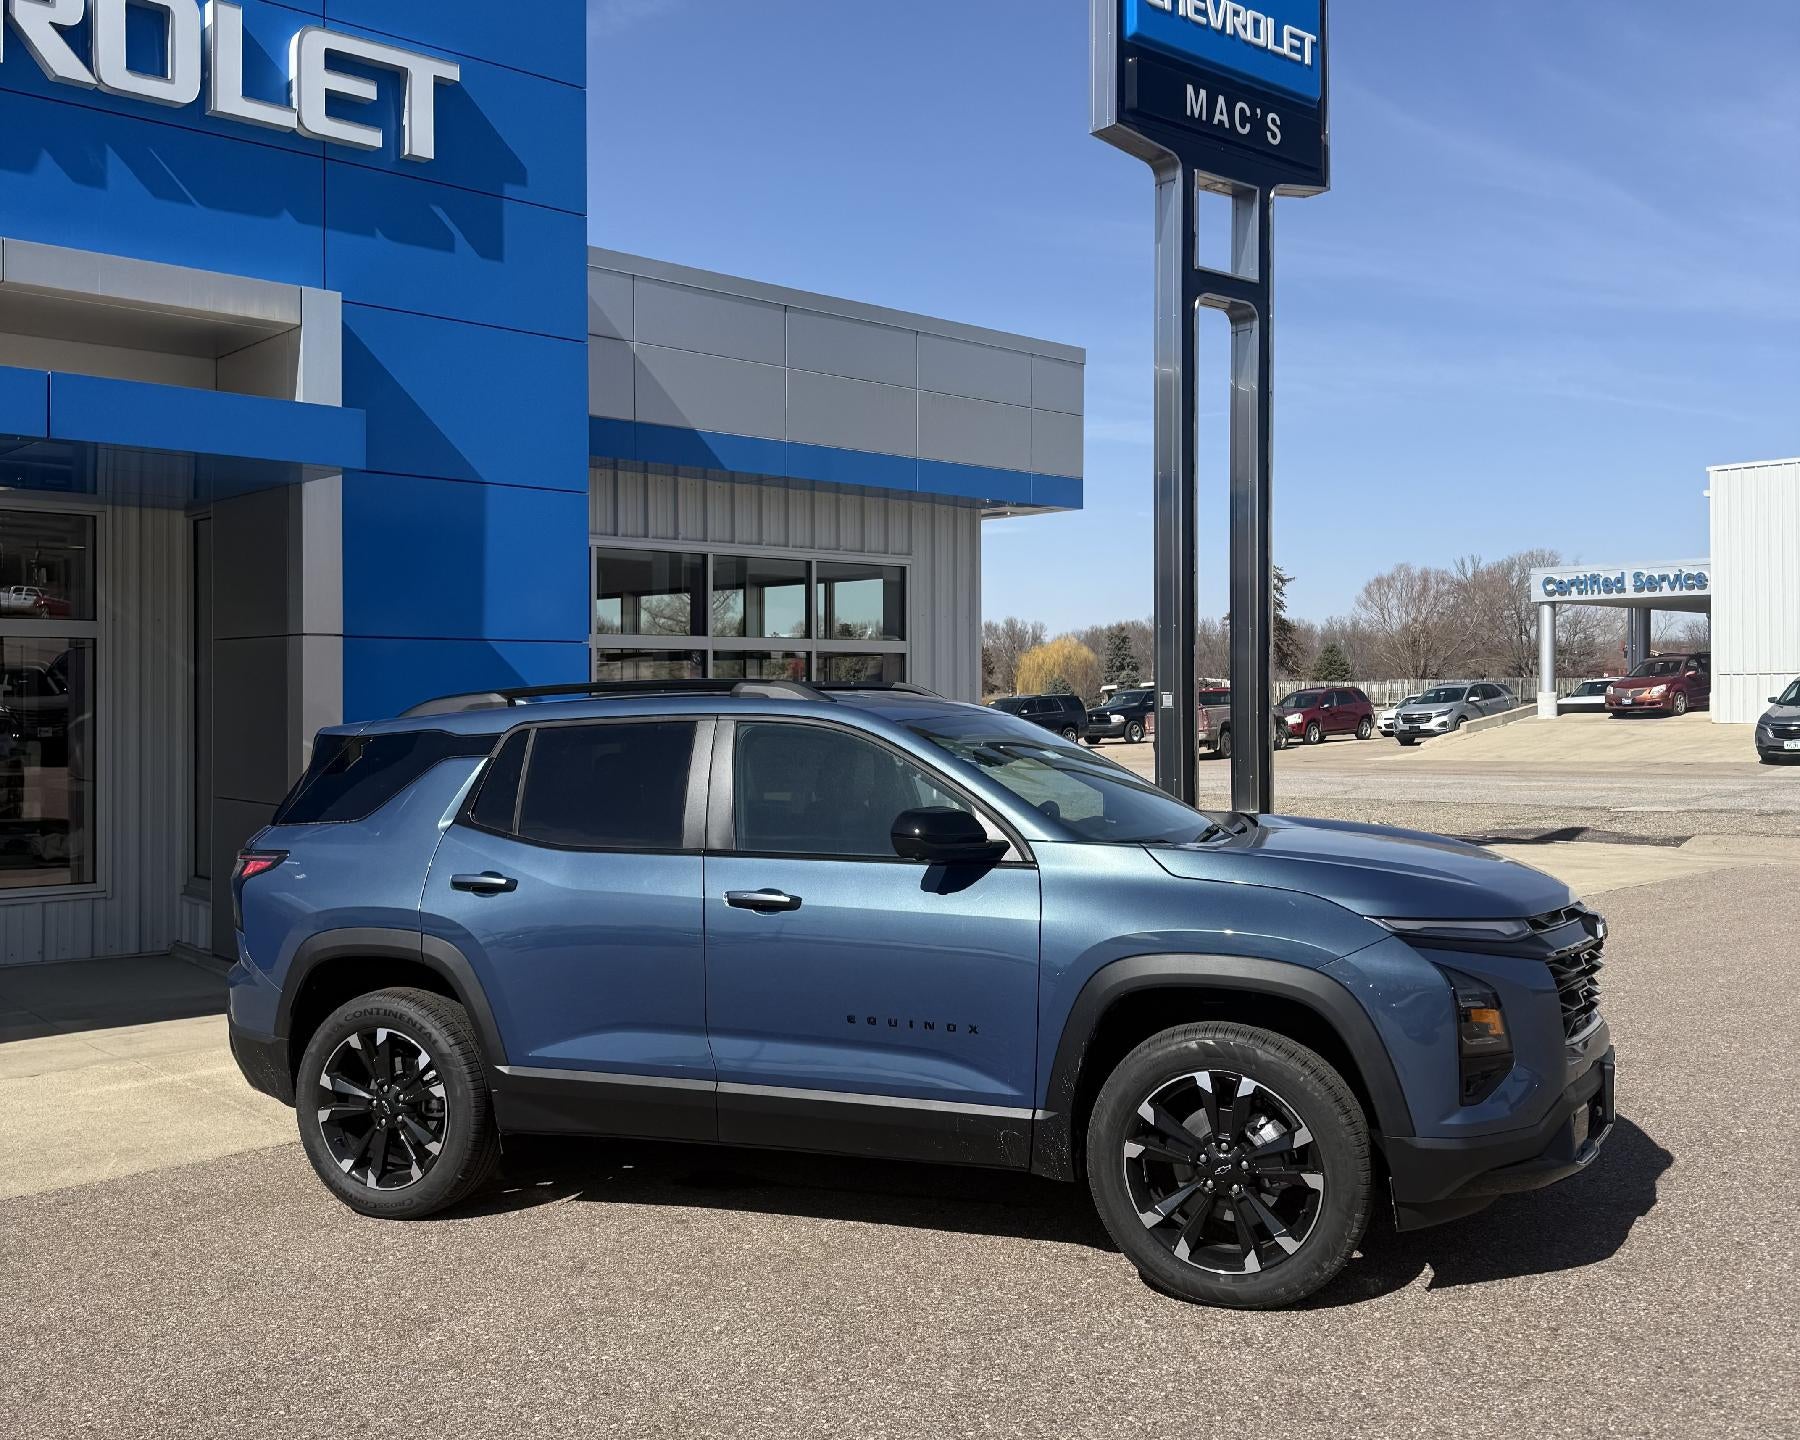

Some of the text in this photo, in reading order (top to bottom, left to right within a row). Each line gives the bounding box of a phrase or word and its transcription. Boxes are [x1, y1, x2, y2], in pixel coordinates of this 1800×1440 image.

[1144, 0, 1317, 67] EVROLET
[1186, 83, 1281, 146] MAC'S
[1542, 568, 1708, 597] Certified Service
[847, 1014, 979, 1035] EQUINOX
